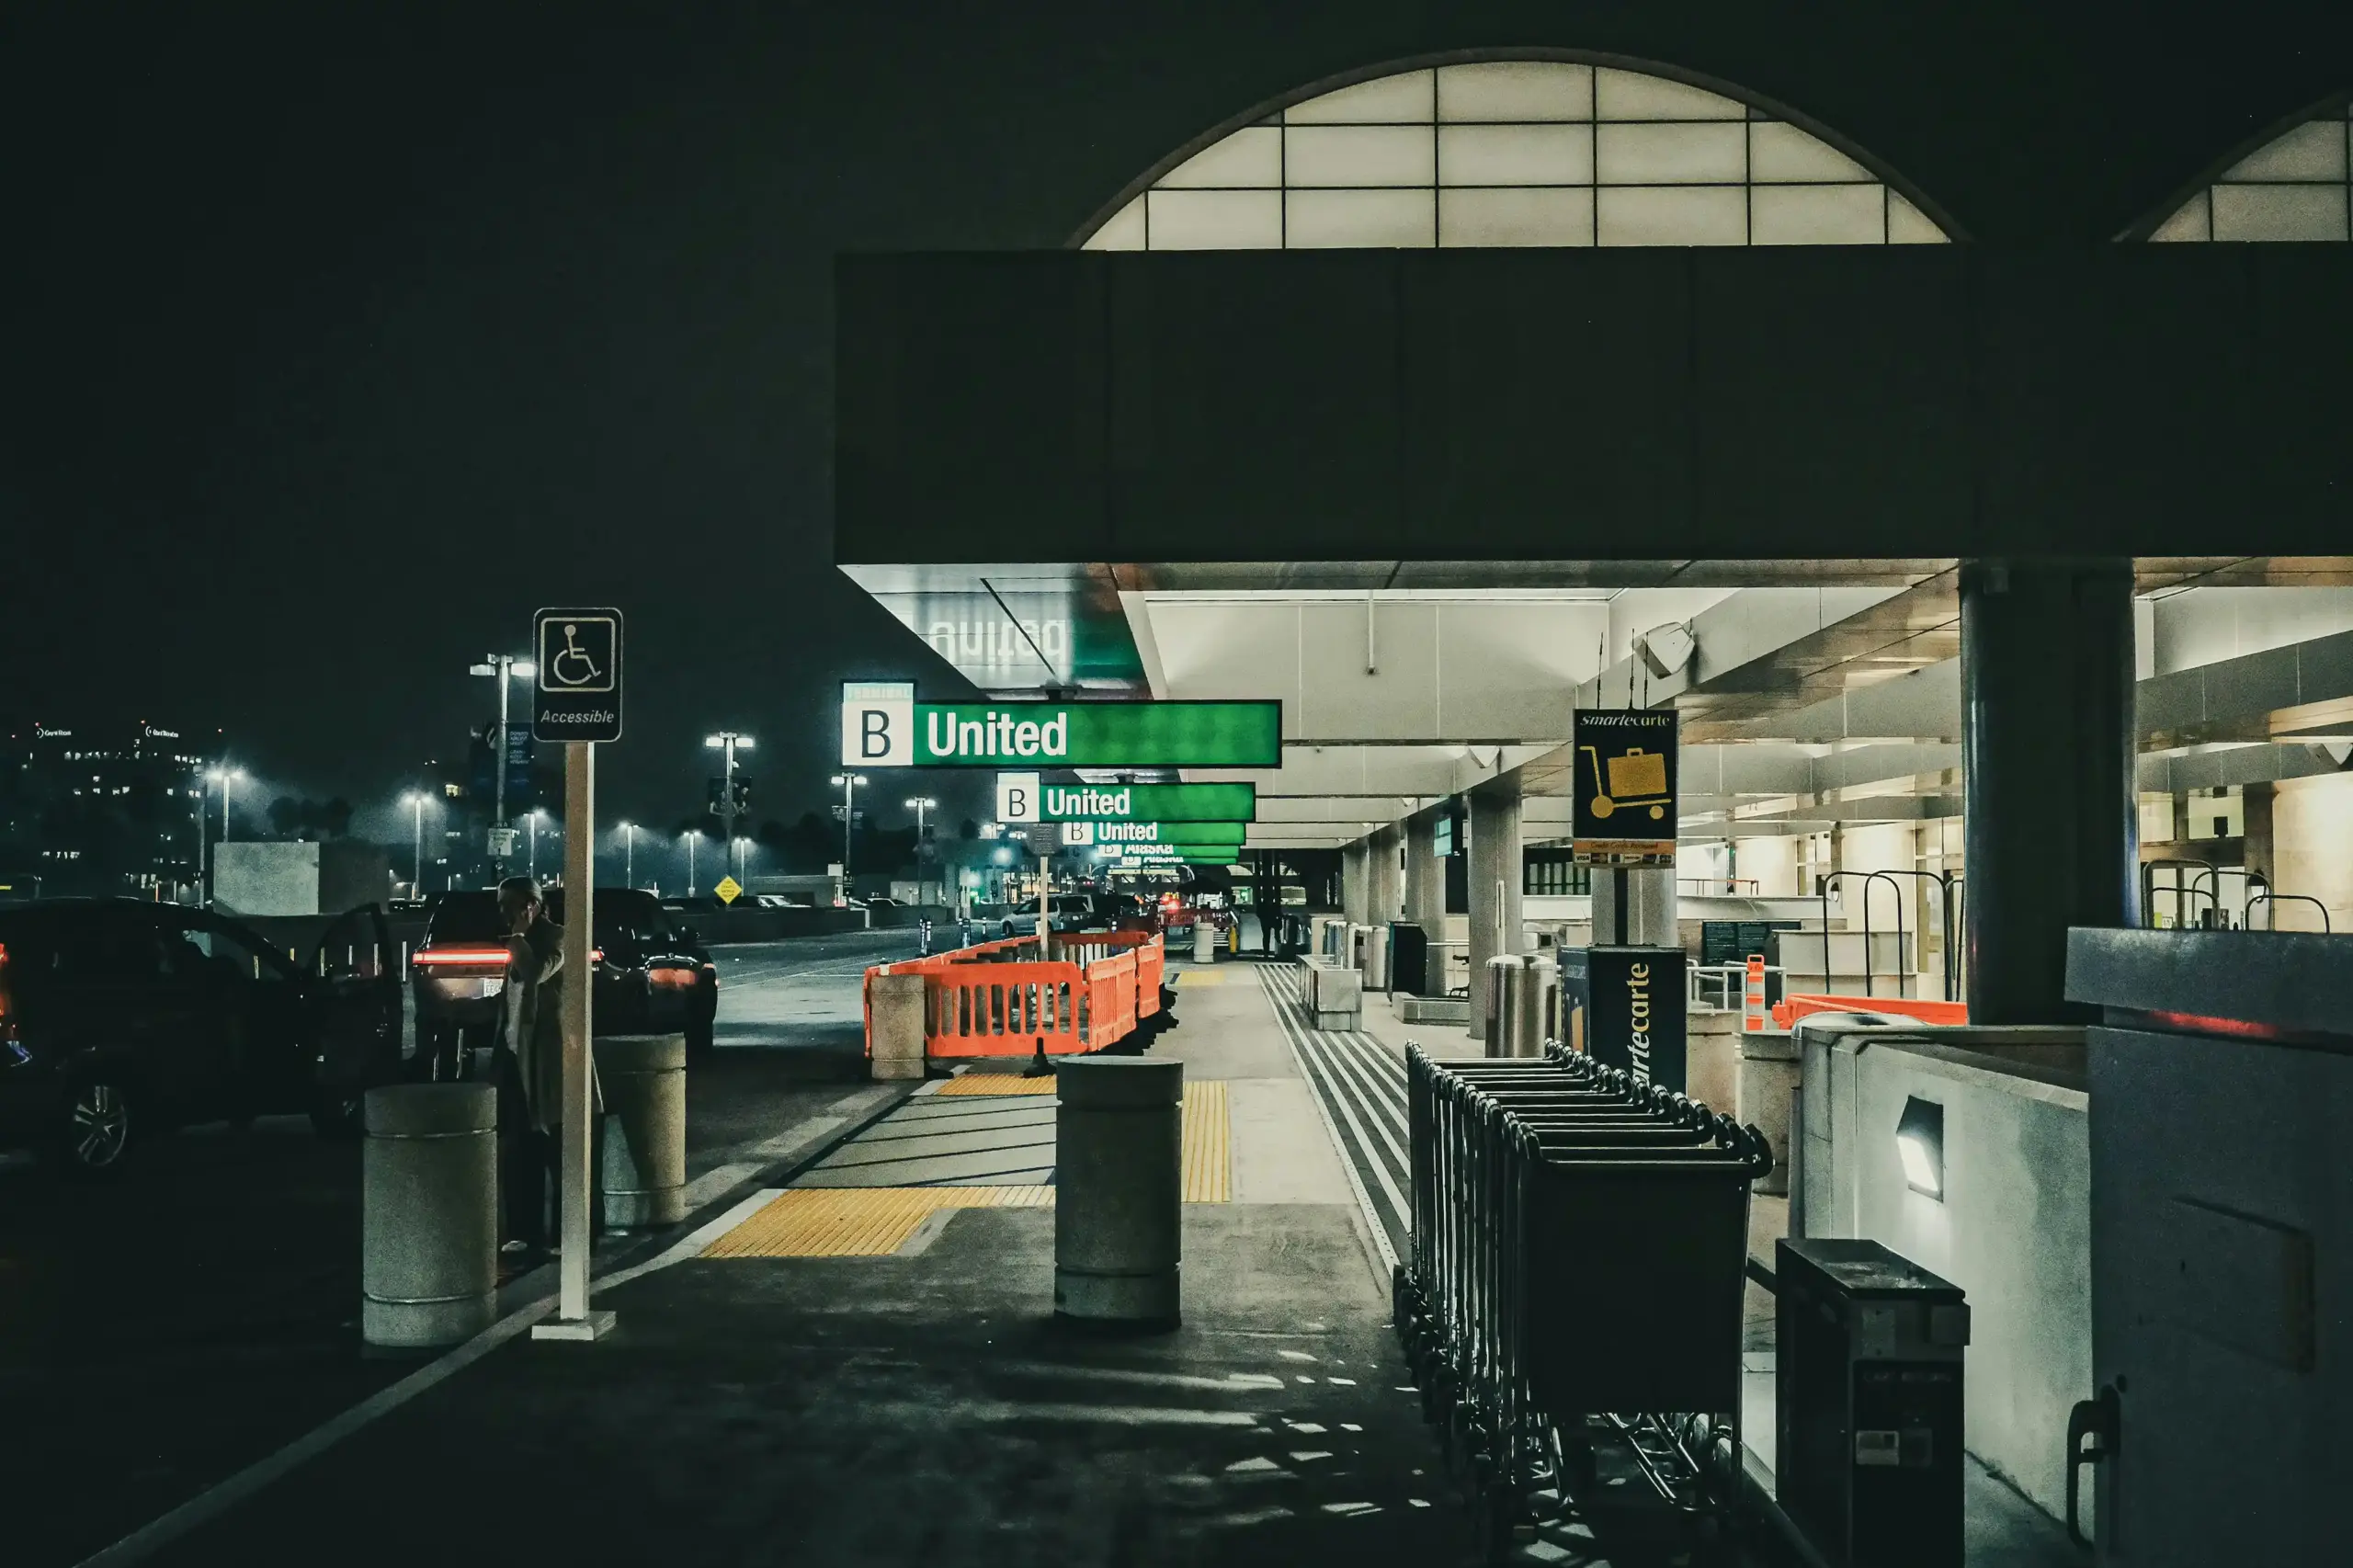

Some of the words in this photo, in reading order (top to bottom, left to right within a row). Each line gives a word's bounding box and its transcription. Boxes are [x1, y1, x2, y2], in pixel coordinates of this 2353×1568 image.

[540, 710, 614, 722] Accessible
[1580, 714, 1669, 726] smartecarte
[861, 710, 891, 758] B
[927, 711, 1067, 756] United
[1008, 789, 1026, 817] B
[1047, 788, 1131, 815] United
[1071, 822, 1083, 840] B
[1098, 822, 1157, 840] United
[1626, 962, 1651, 1086] artecarte
